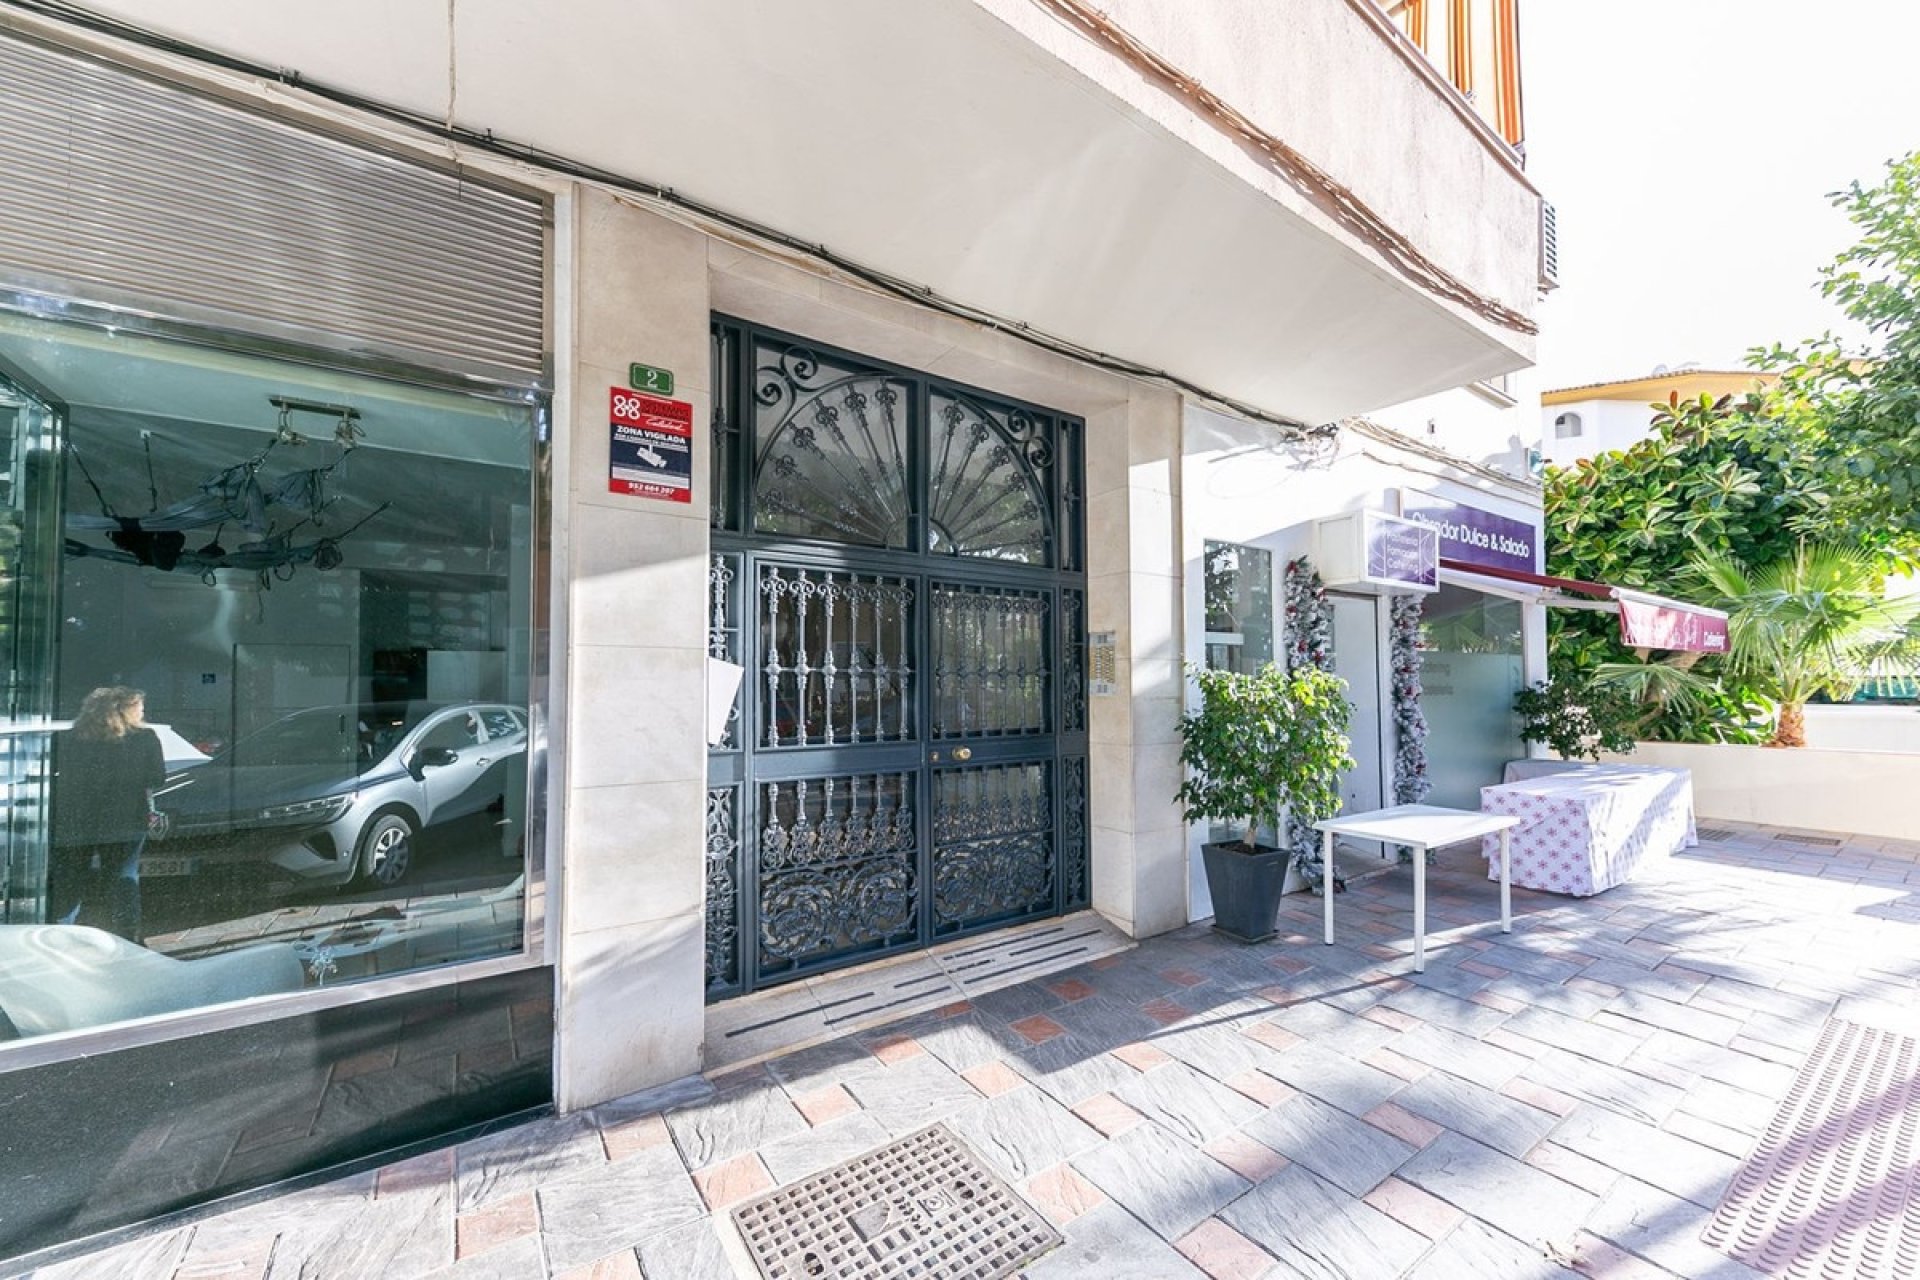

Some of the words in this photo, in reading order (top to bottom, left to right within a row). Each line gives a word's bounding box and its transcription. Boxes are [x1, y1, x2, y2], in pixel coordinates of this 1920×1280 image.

[647, 369, 659, 388] 2
[617, 425, 643, 437] ZONA
[644, 430, 686, 444] VIGILADA
[1412, 511, 1459, 541] Oador
[1460, 524, 1489, 550] Dulce
[1490, 533, 1499, 551] &
[1499, 535, 1530, 558] Salado
